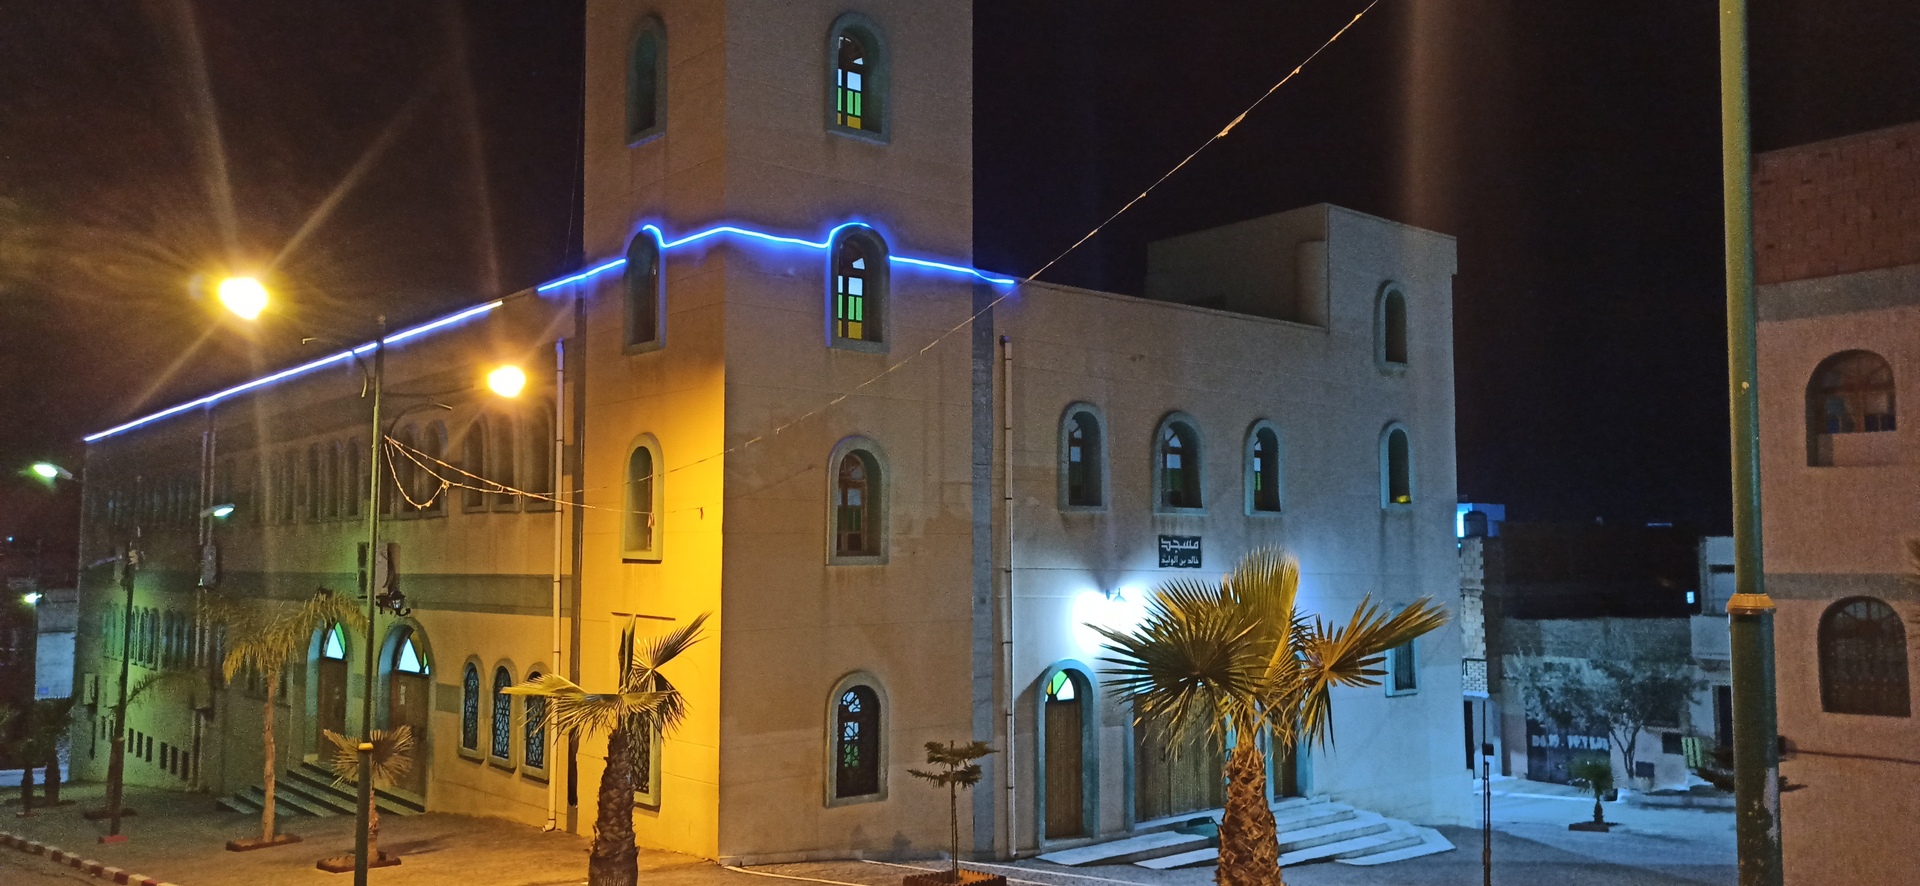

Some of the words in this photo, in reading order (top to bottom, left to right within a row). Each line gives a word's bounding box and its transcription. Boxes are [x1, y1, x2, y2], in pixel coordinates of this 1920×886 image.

[1161, 538, 1199, 553] مسجد
[1161, 555, 1179, 566] الوليد
[1187, 555, 1199, 564] خالد
